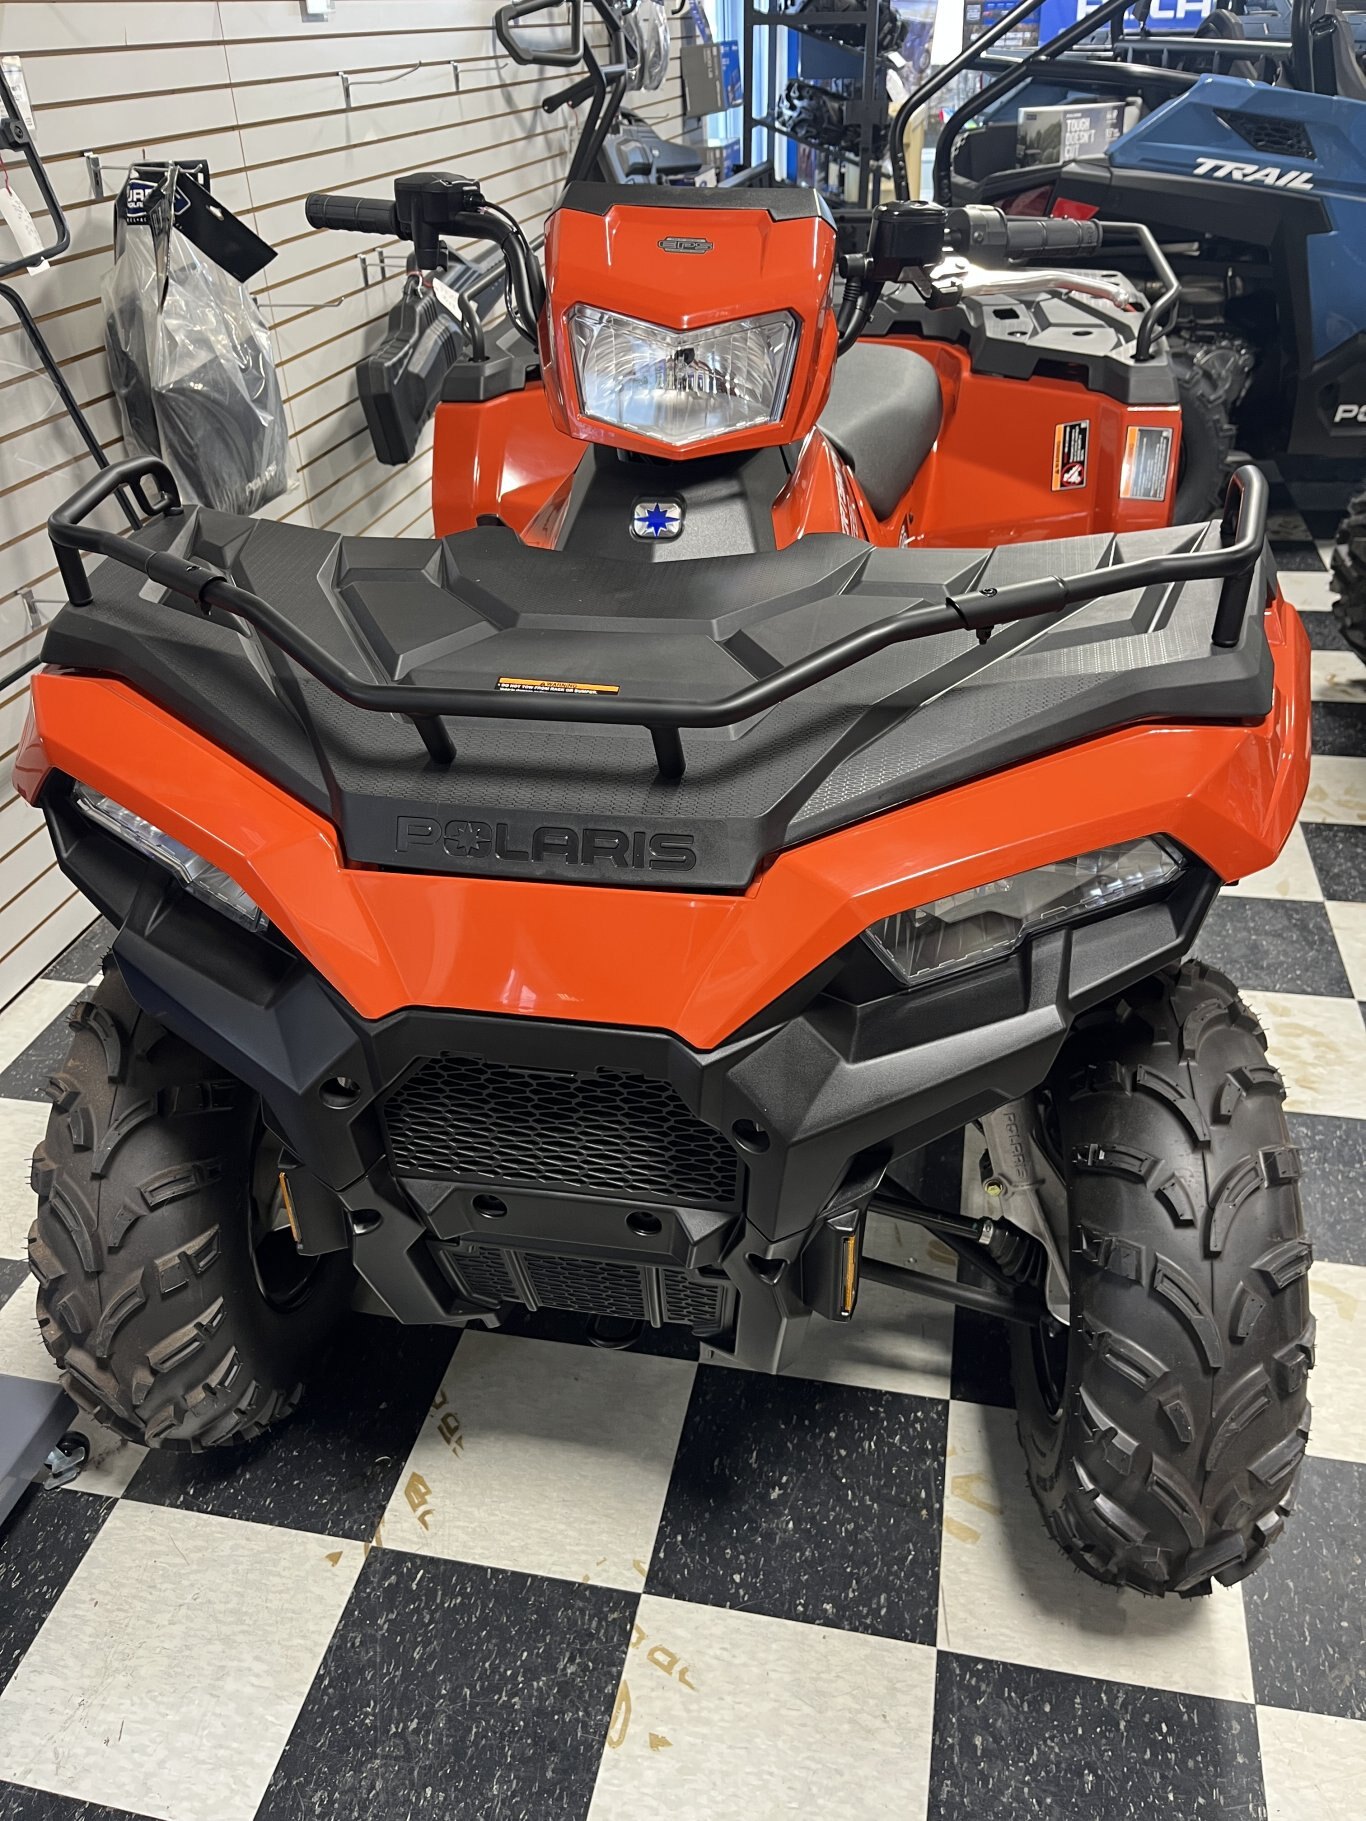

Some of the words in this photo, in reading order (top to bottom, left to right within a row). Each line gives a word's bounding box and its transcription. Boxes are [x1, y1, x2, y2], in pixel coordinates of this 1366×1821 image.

[1066, 118, 1091, 132] TOUGH
[1193, 157, 1314, 190] TRAIL
[396, 815, 697, 871] POLARIS
[1003, 1112, 1028, 1178] POLARIS
